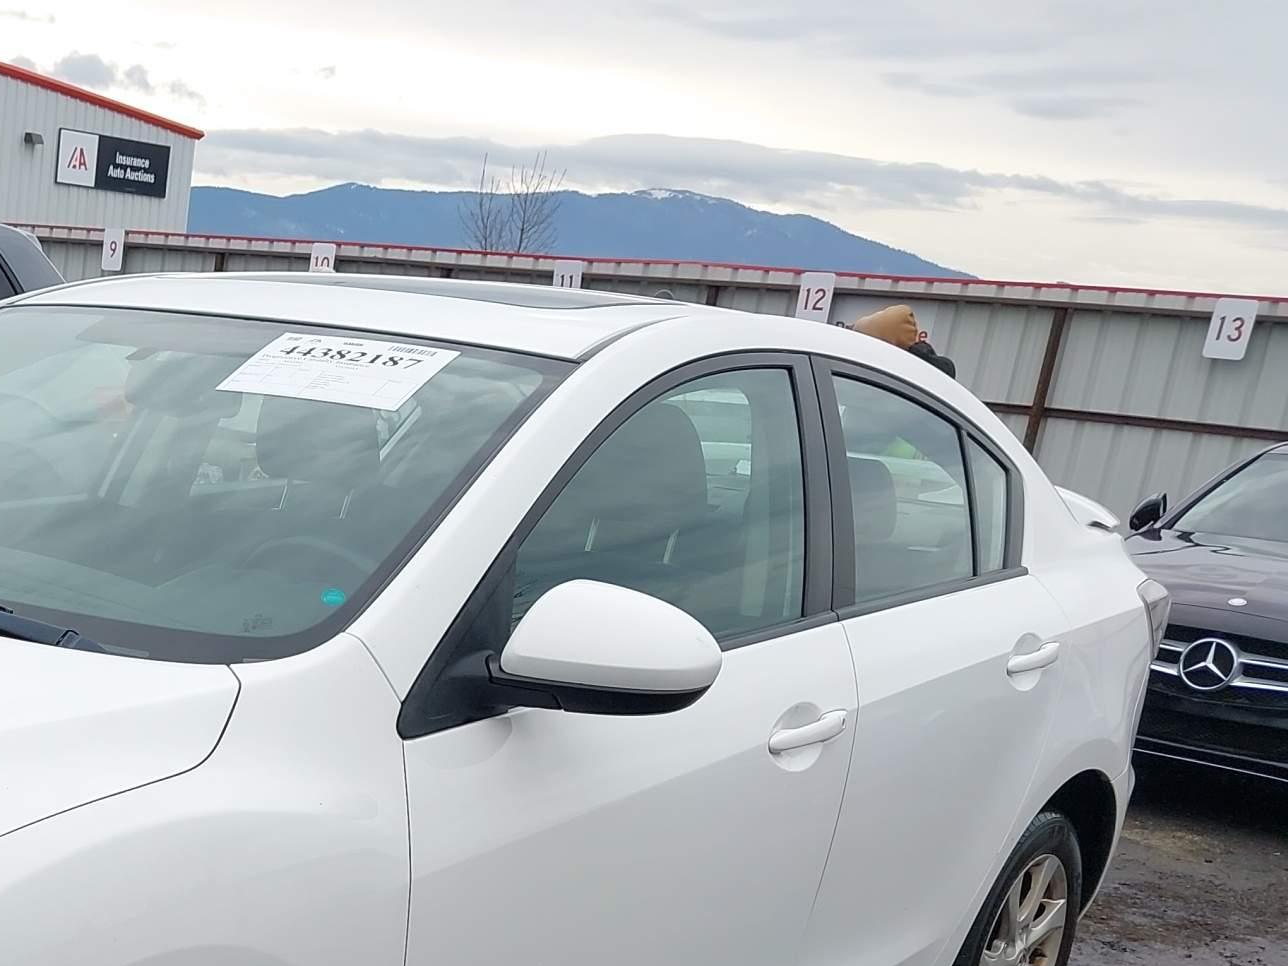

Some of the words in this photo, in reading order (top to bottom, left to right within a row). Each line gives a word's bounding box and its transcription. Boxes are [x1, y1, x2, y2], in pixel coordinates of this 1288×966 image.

[115, 151, 150, 168] Insurance
[107, 164, 125, 178] Auto
[125, 167, 155, 183] Auctions
[109, 241, 117, 257] 9
[314, 255, 330, 268] 10
[560, 274, 573, 288] 11
[803, 288, 827, 311] 12
[1215, 315, 1245, 342] 13
[279, 345, 424, 369] 44382187
